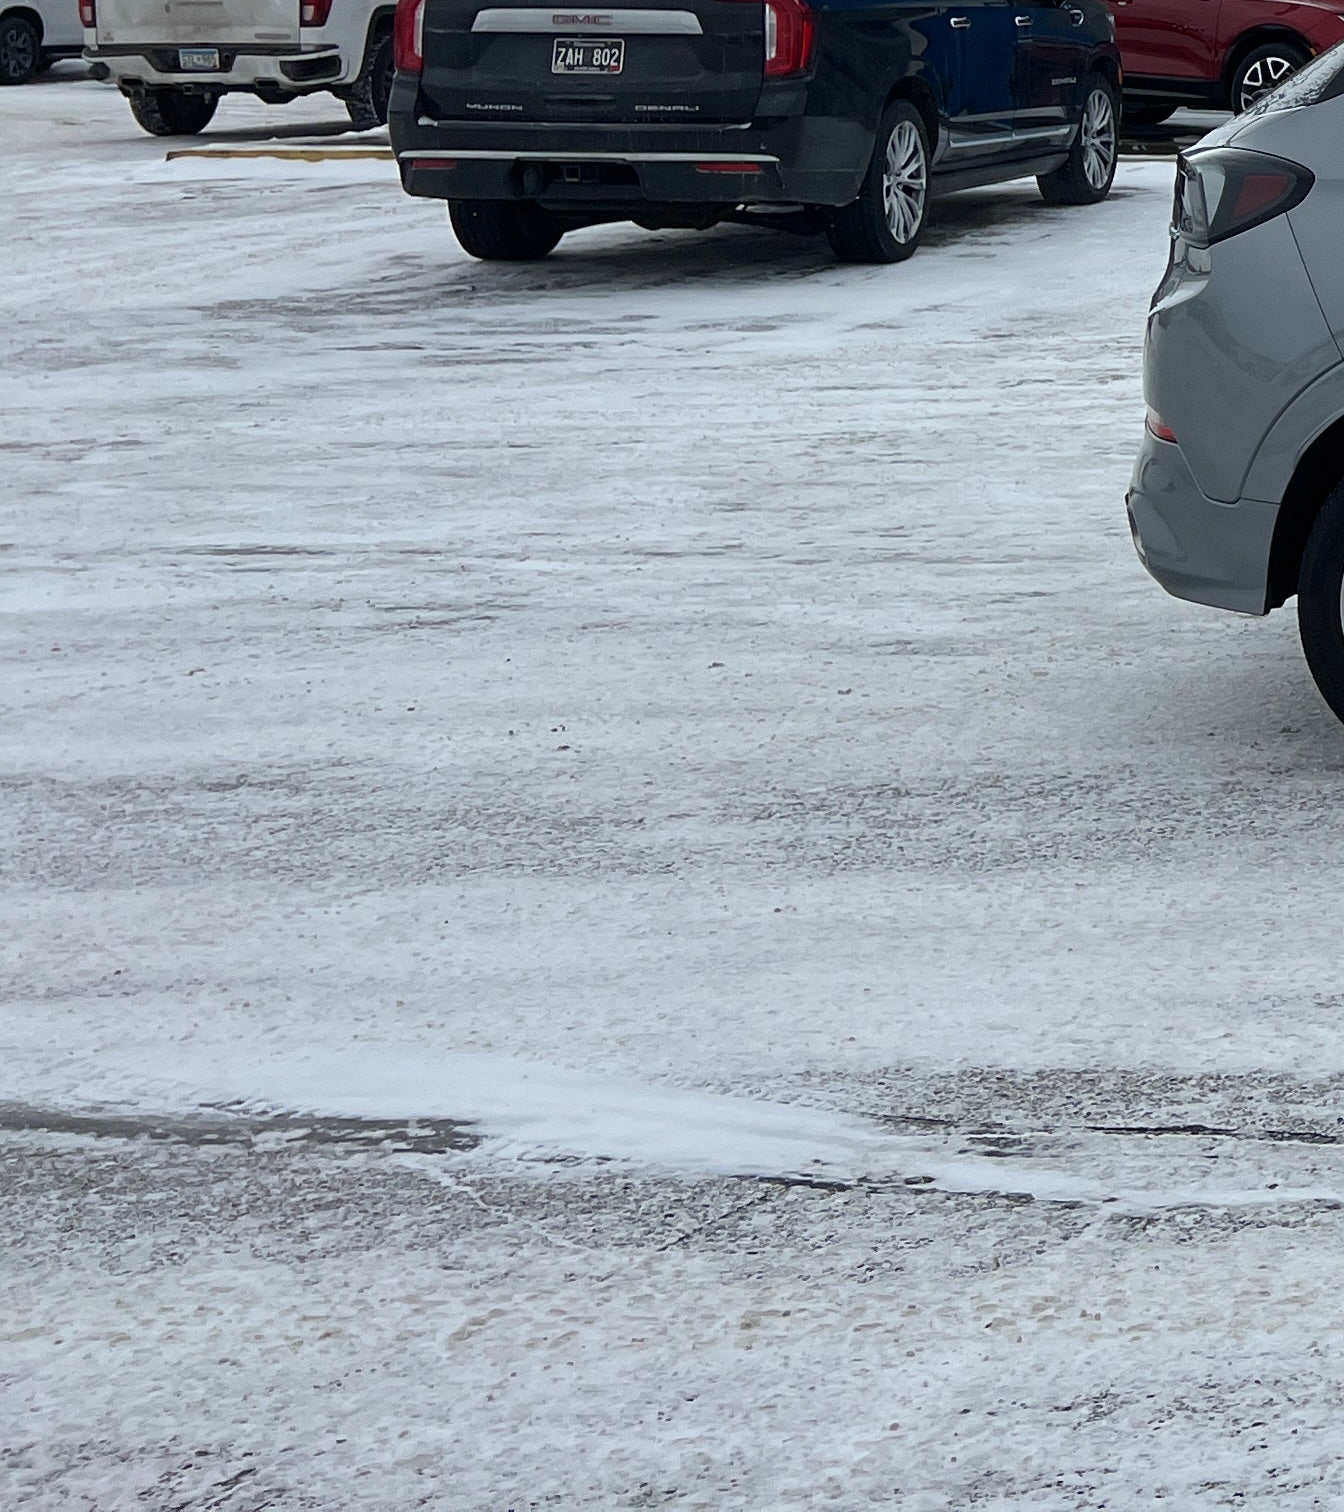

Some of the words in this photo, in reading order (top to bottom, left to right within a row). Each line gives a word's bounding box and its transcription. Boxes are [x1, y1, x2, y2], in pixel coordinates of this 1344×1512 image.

[551, 14, 614, 26] GMC
[556, 47, 584, 66] ZAH
[592, 48, 620, 66] 802
